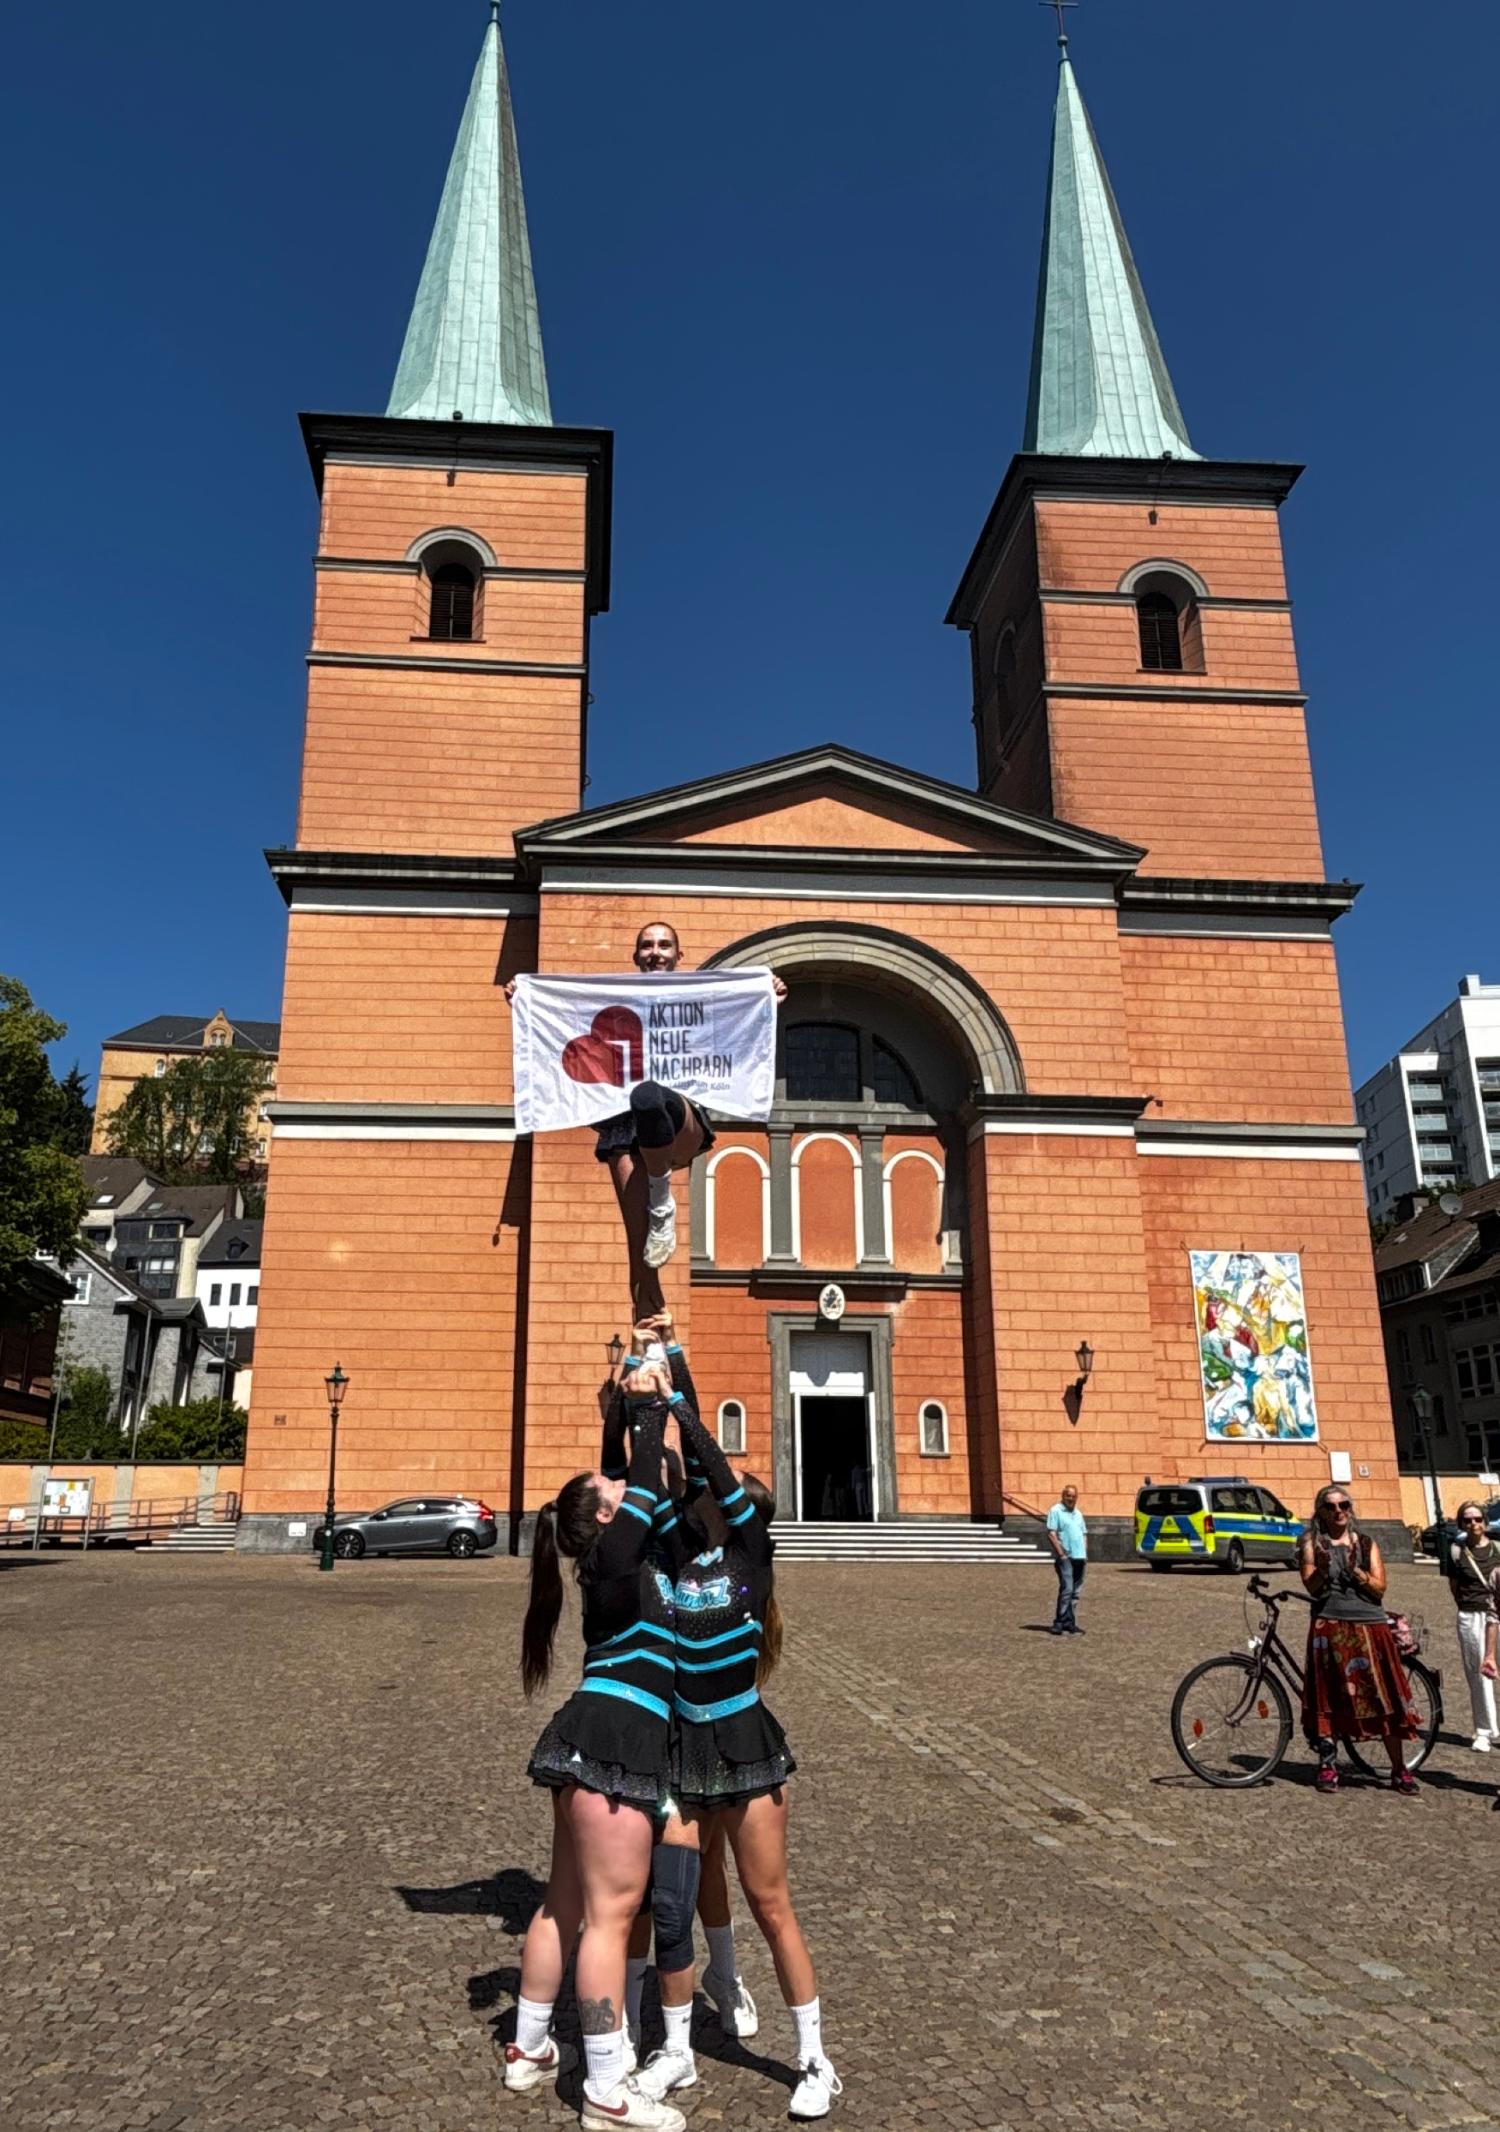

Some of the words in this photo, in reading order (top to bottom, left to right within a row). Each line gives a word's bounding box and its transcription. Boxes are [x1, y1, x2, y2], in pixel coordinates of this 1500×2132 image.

[649, 1002, 704, 1028] AKTION
[649, 1030, 692, 1055] NEUE
[649, 1054, 732, 1081] NACHBARN
